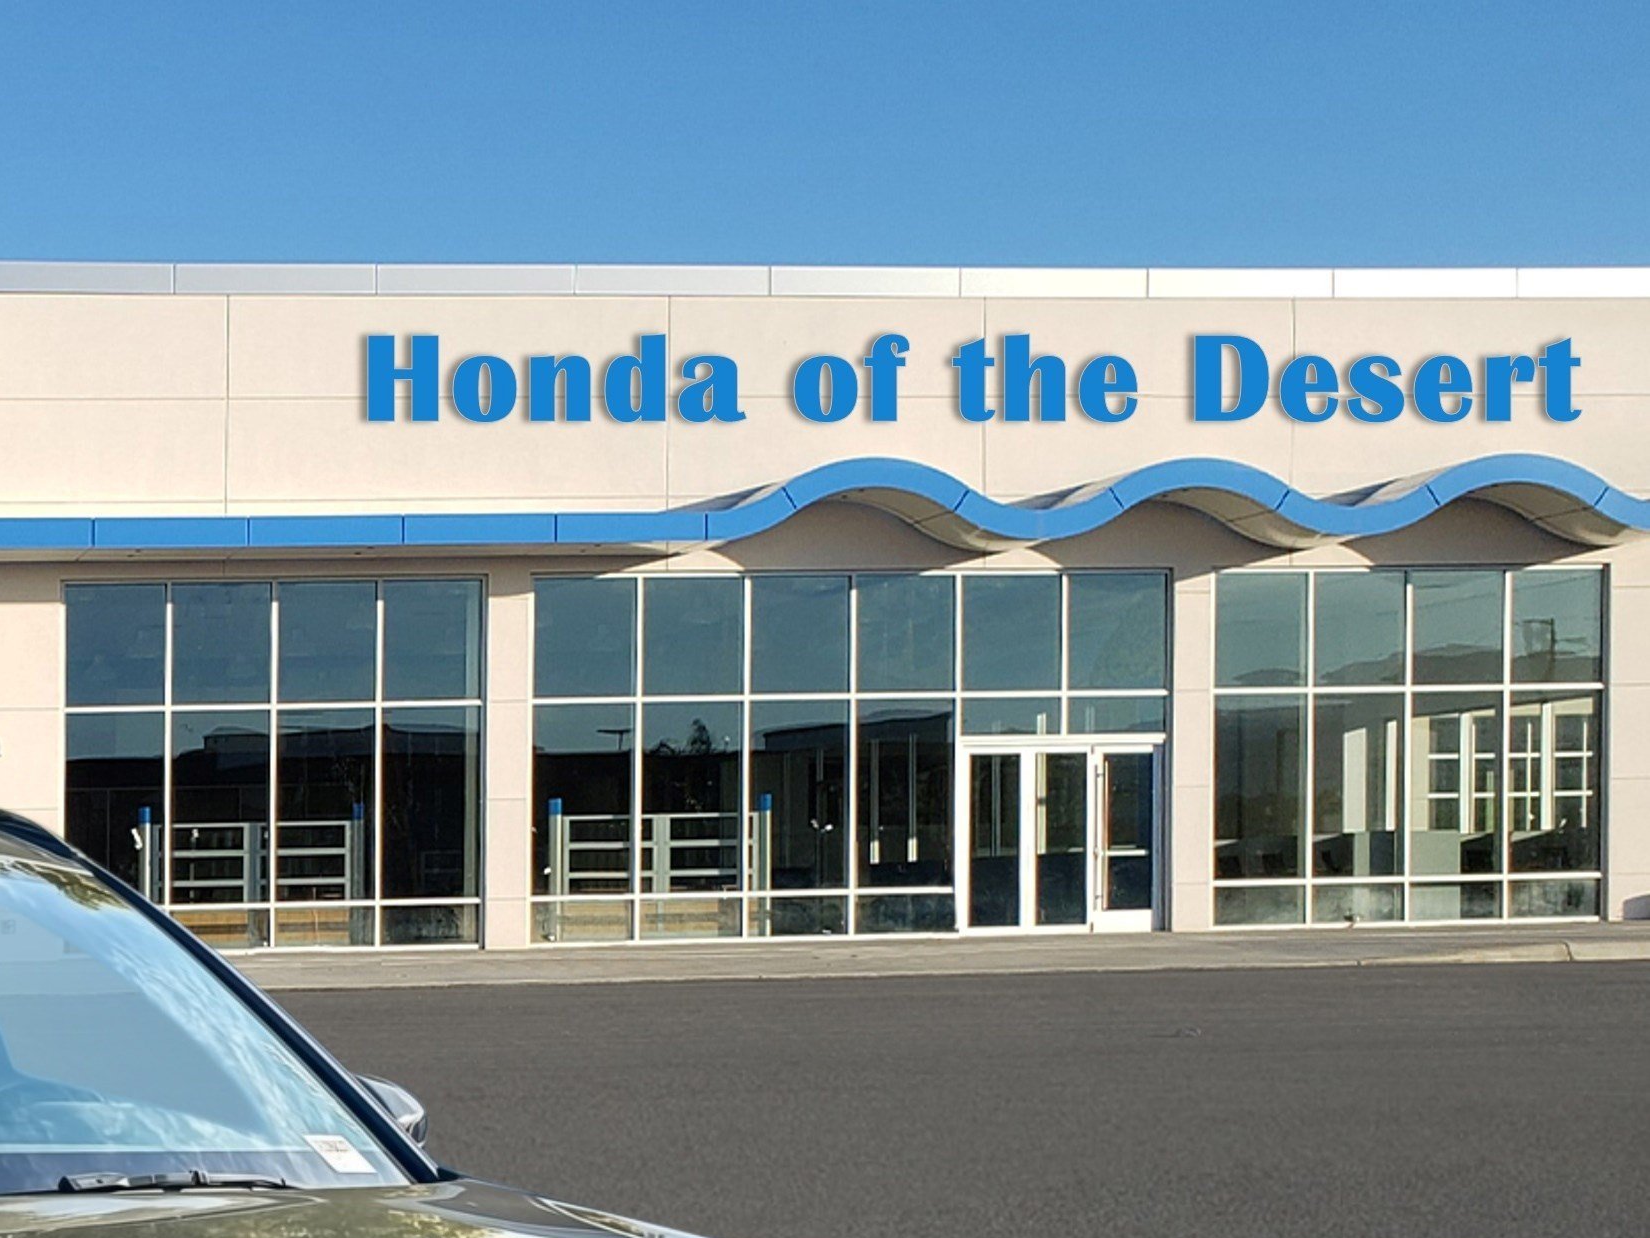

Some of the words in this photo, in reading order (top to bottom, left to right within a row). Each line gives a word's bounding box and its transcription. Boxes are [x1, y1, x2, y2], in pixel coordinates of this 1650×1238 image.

[365, 332, 746, 424] Honda
[793, 332, 911, 424] of
[951, 332, 1138, 424] the
[1192, 333, 1582, 424] Desert
